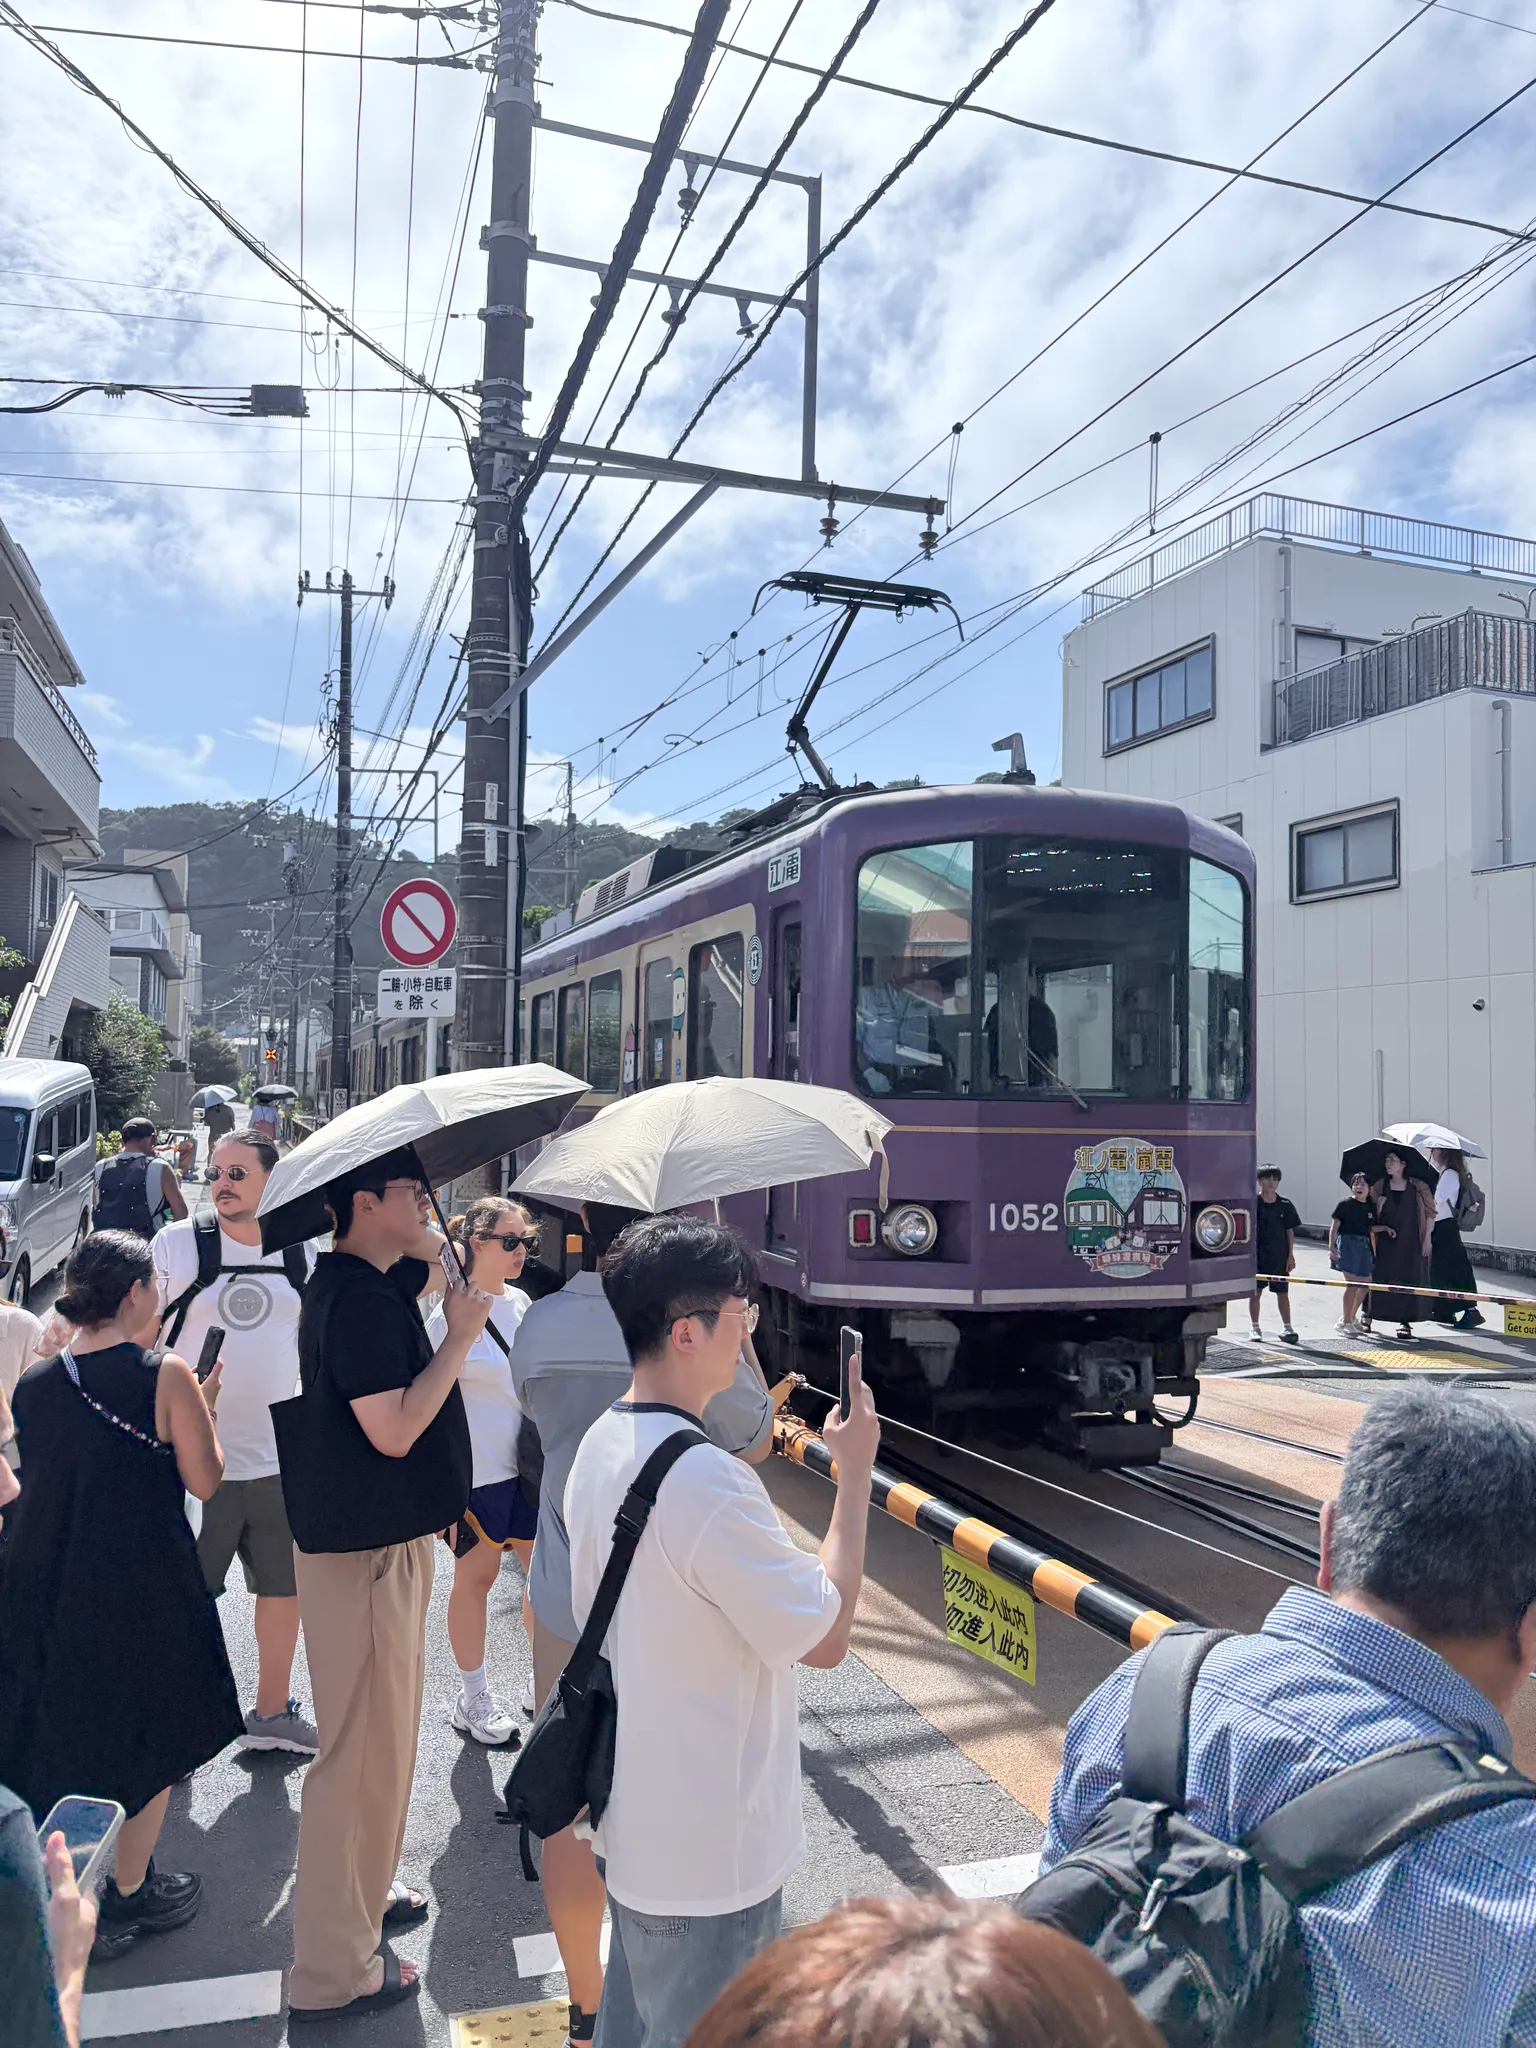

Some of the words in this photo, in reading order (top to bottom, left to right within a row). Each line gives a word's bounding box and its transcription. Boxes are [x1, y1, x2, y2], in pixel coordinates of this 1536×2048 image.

[382, 976, 453, 993] 二輪・小特・自転車
[394, 994, 439, 1010] を除く
[989, 1203, 1059, 1231] 1052
[1507, 1322, 1522, 1333] Get
